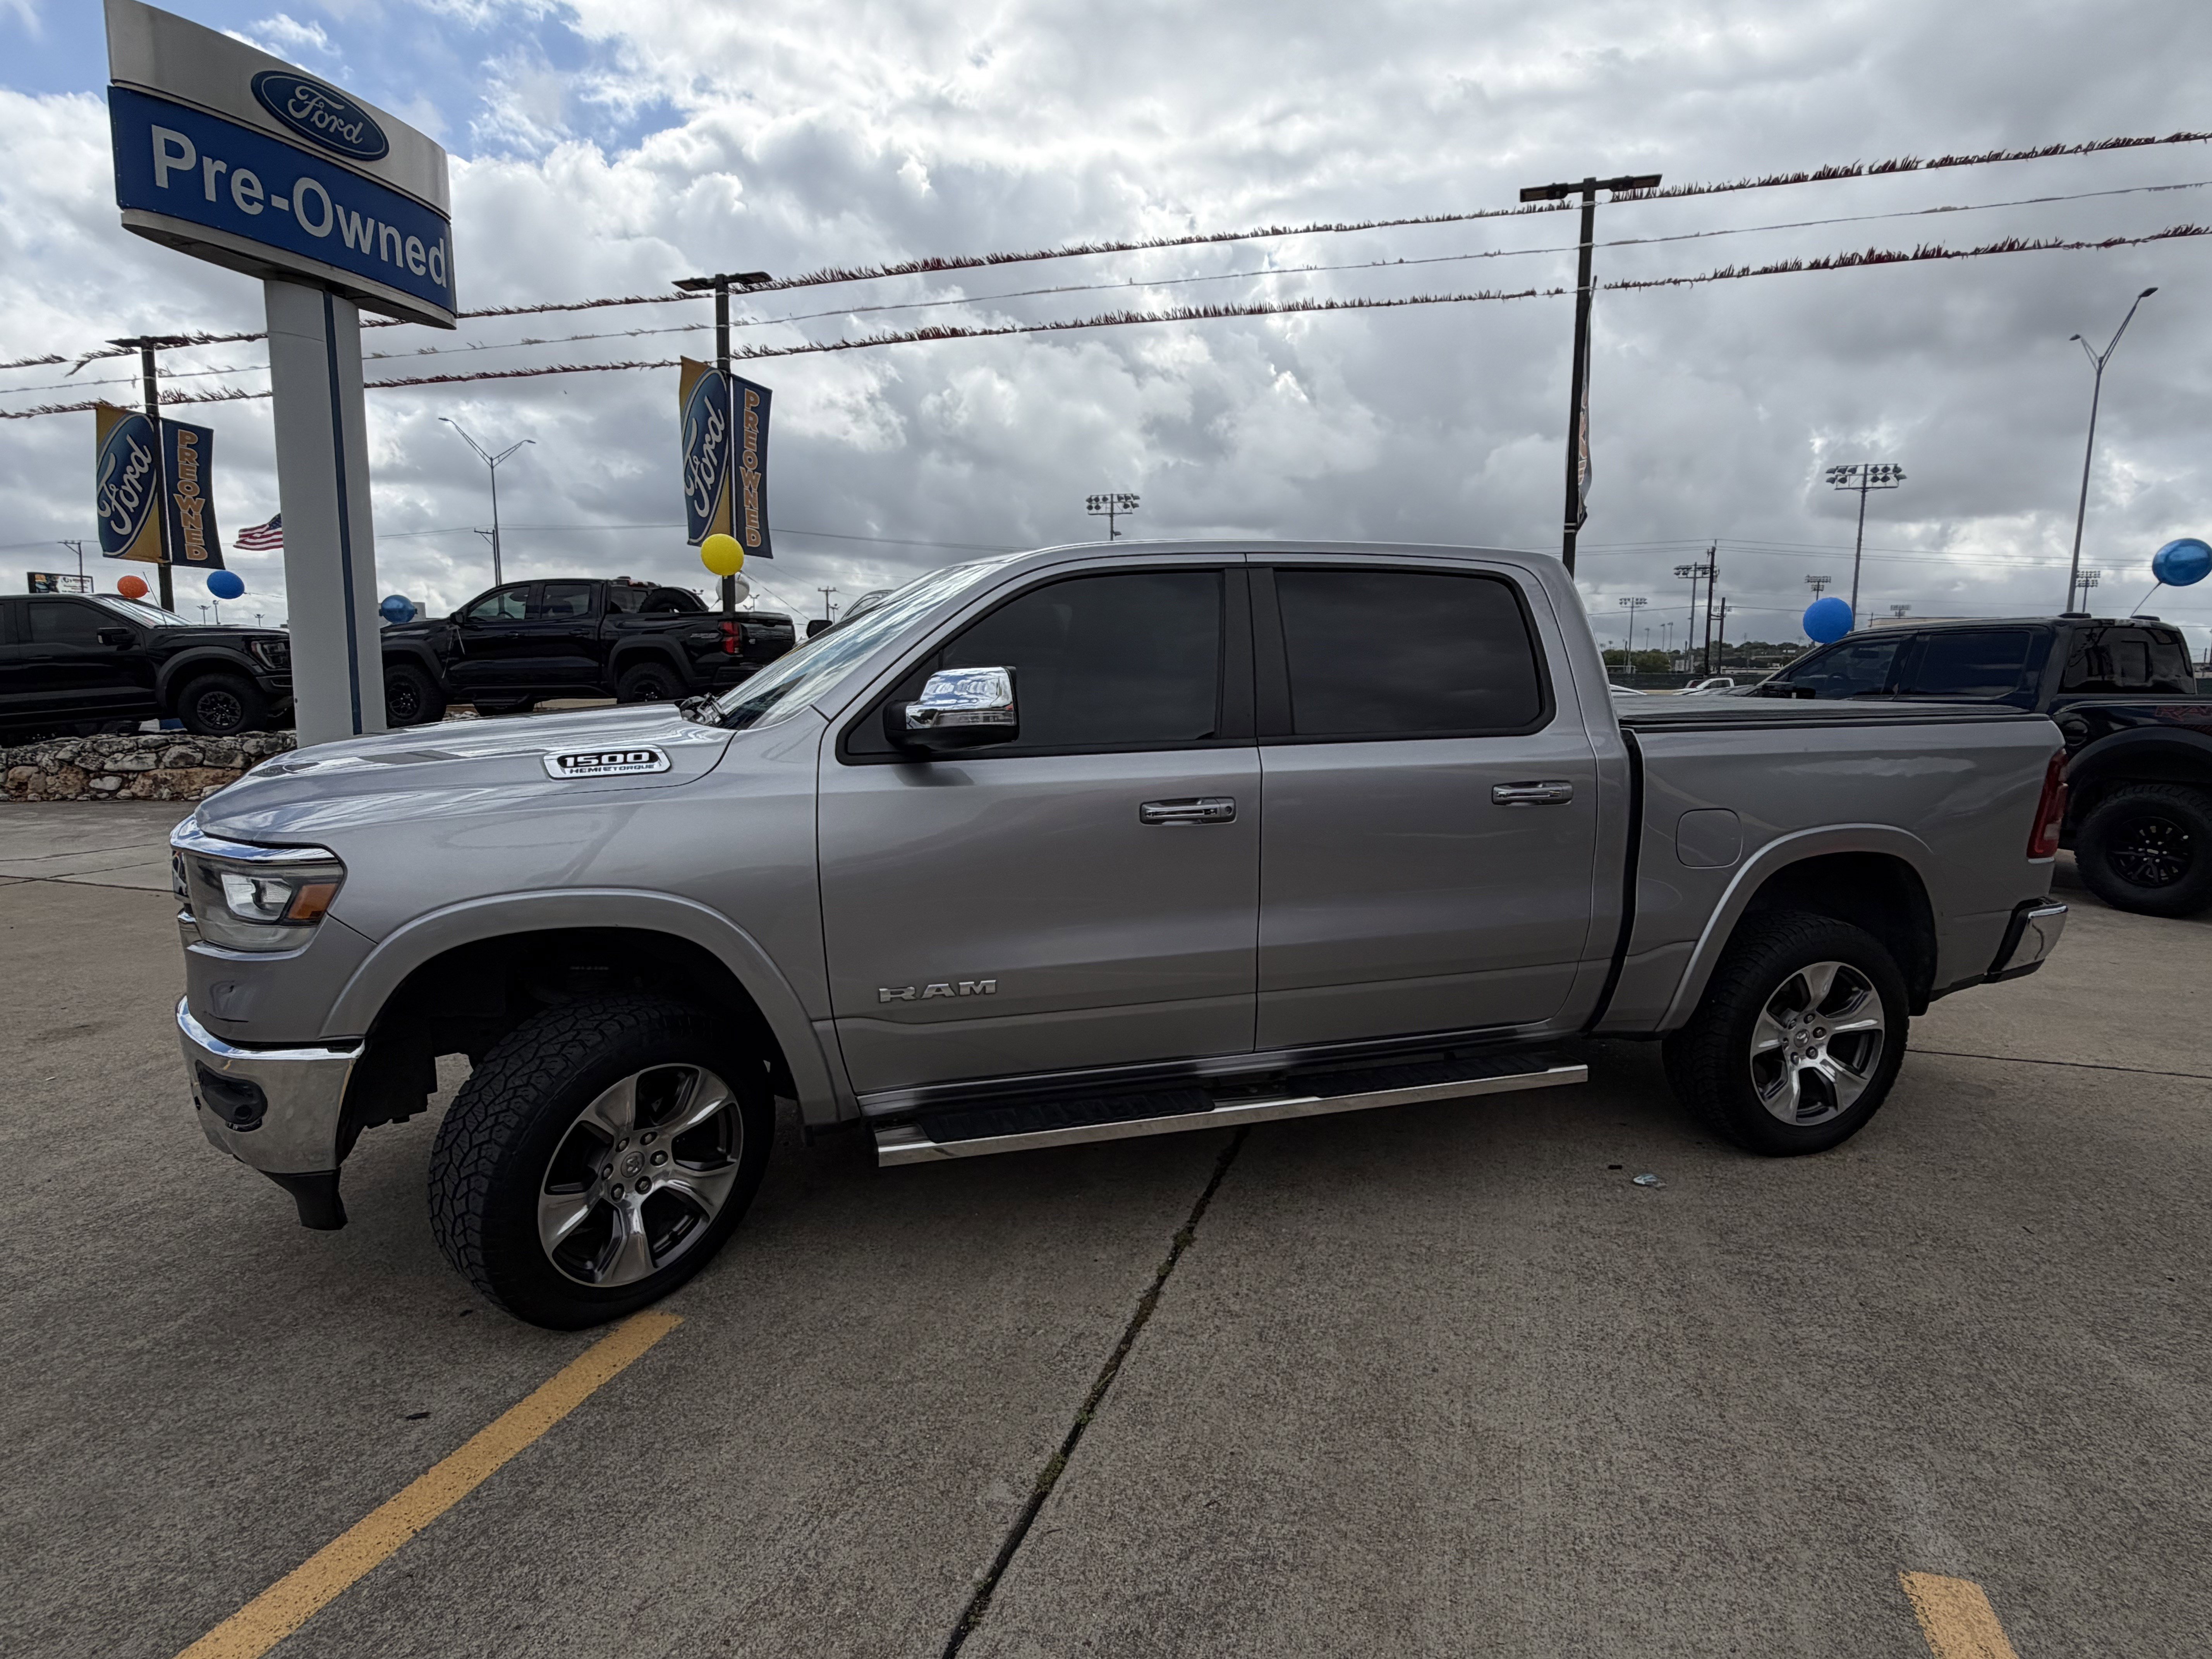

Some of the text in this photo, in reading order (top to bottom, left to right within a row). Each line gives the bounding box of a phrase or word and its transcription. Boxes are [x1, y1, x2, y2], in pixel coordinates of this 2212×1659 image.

[288, 85, 363, 144] Ford
[151, 124, 447, 288] Pre-Owned
[97, 434, 152, 535] Ford
[173, 429, 208, 561] PREOWNED
[684, 396, 725, 517] Ford
[739, 388, 761, 548] PREOWNED
[565, 752, 649, 767] 1500
[879, 979, 996, 1003] RAM
